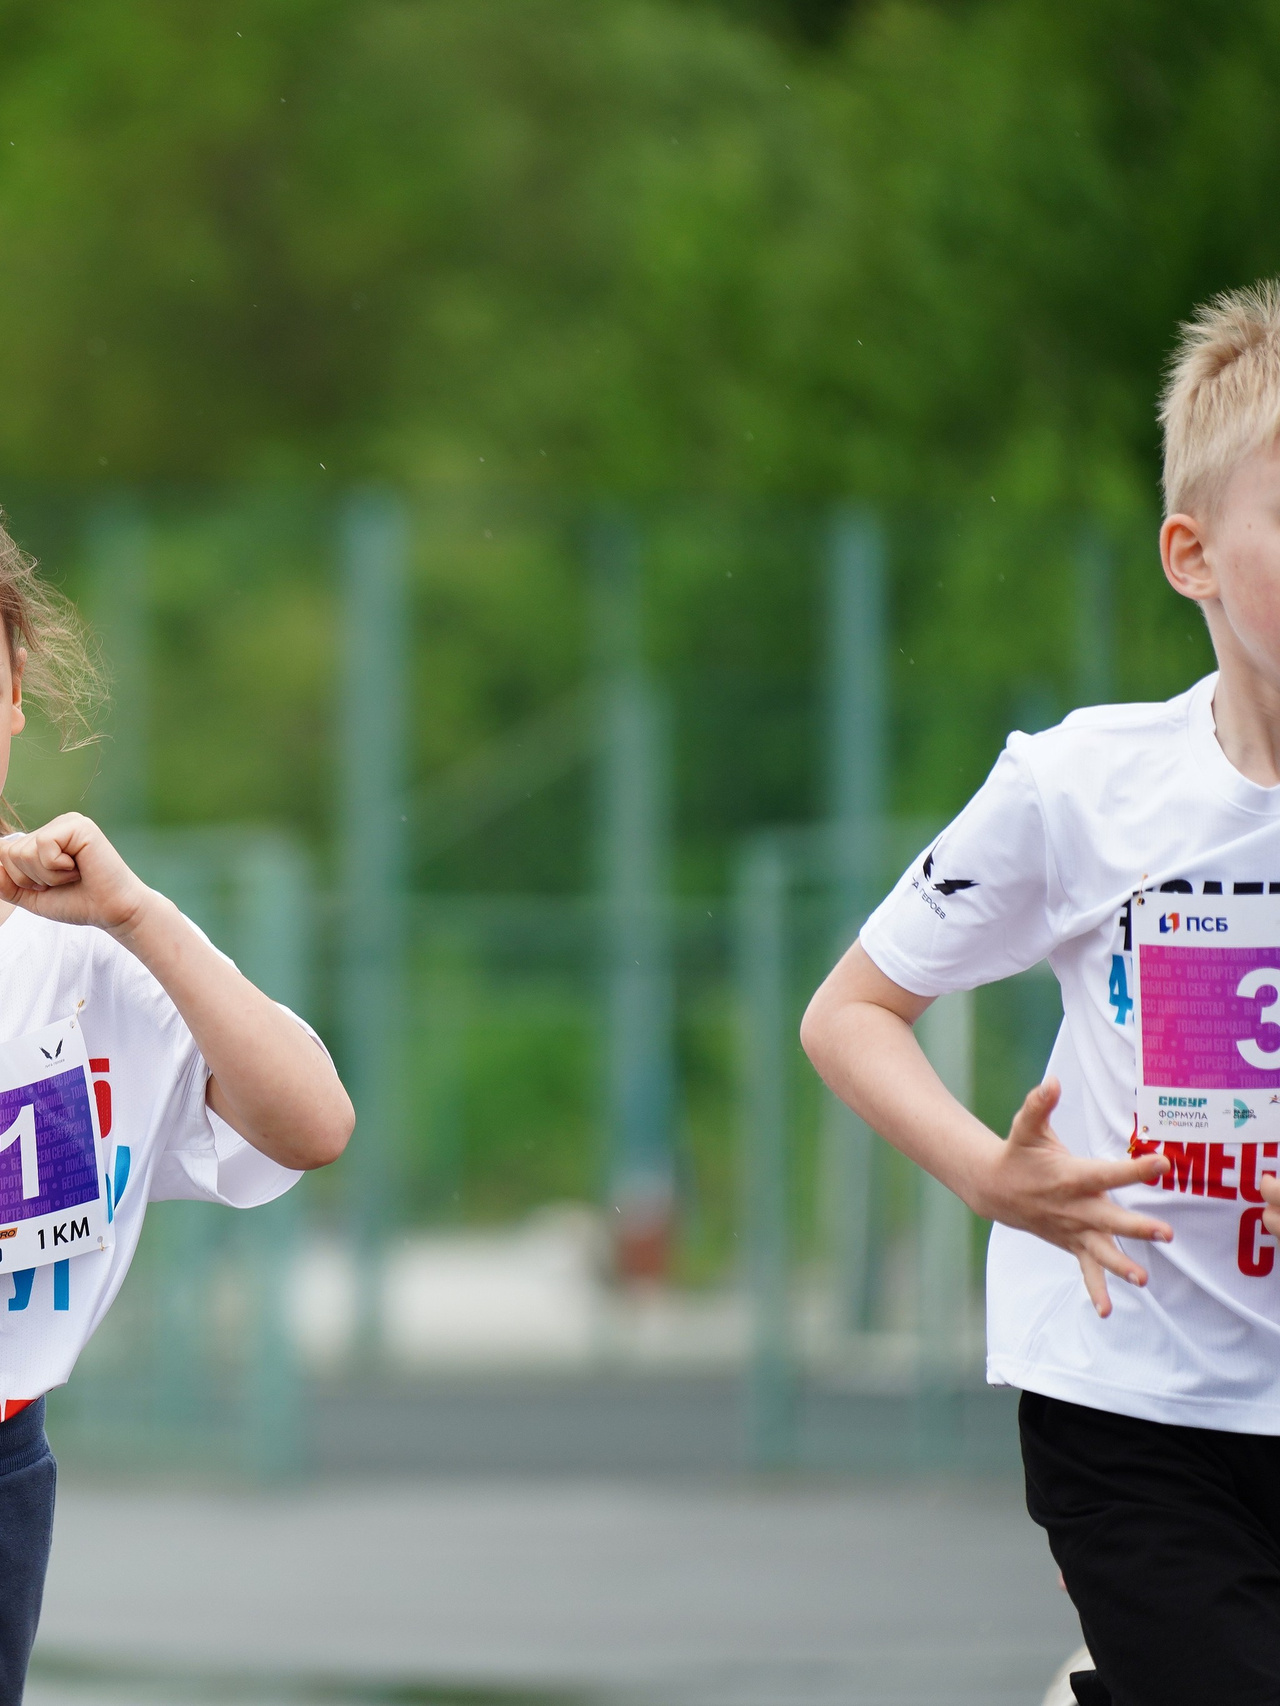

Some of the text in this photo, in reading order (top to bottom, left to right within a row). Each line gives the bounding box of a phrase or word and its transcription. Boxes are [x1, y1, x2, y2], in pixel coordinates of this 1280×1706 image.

[1186, 917, 1229, 932] ПСБ
[1159, 1096, 1207, 1108] СИБУР
[1159, 1109, 1208, 1120] ФОРМУЛА
[37, 1229, 46, 1250] 1
